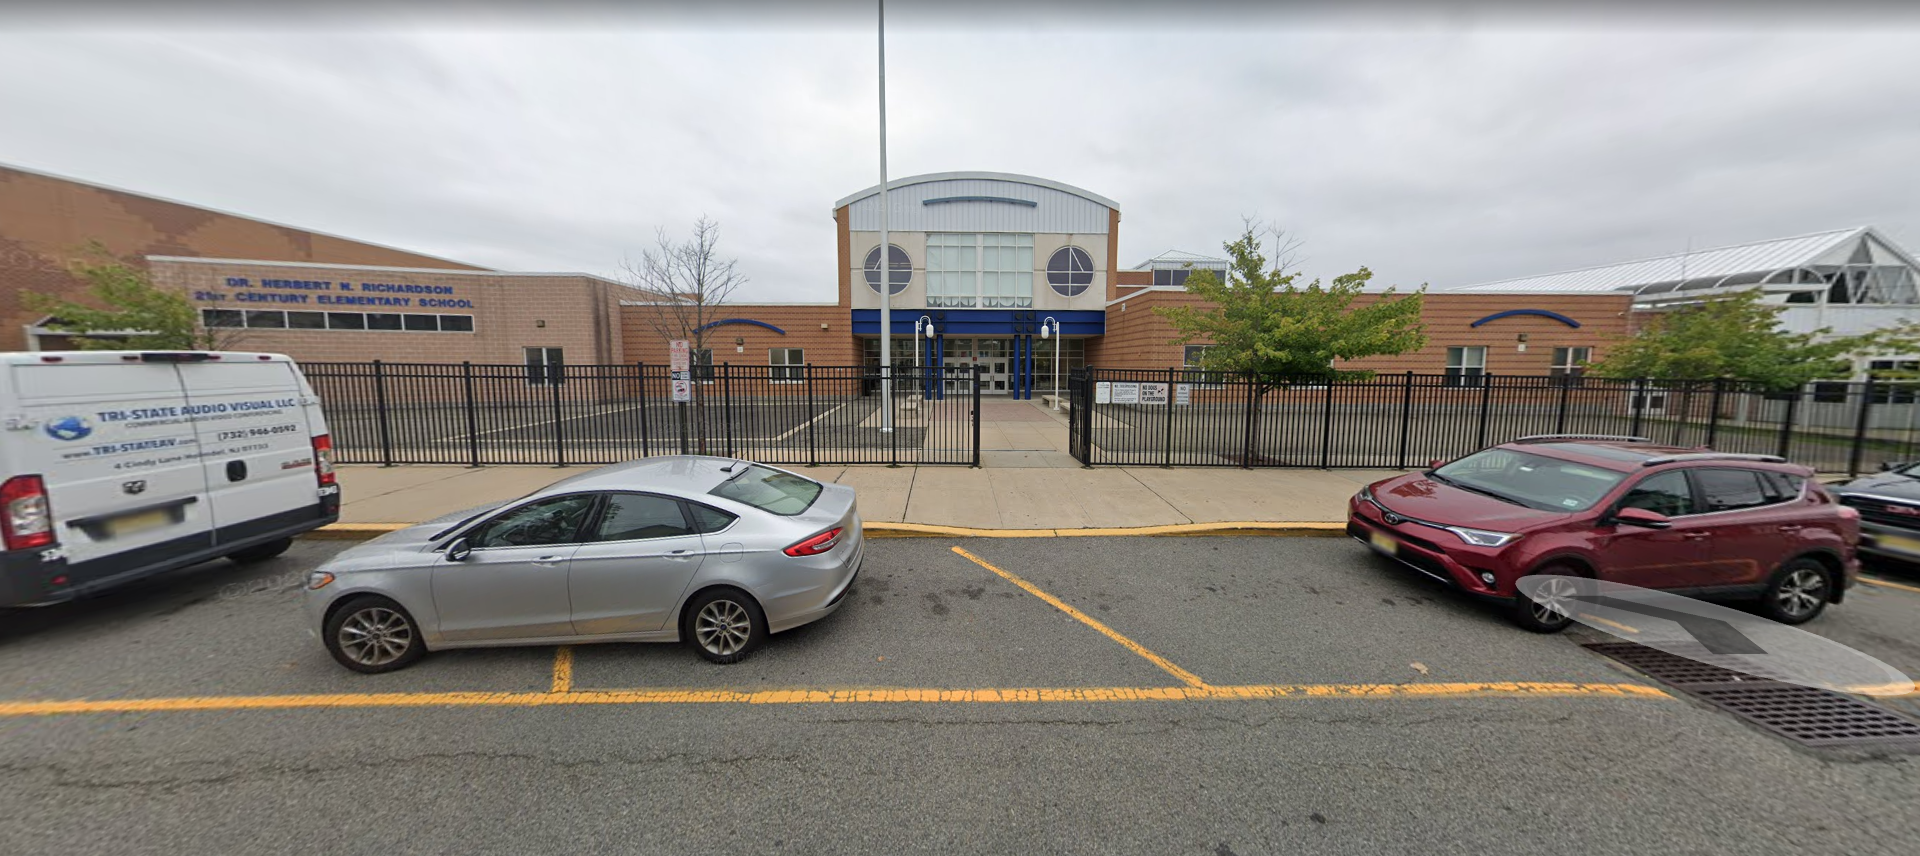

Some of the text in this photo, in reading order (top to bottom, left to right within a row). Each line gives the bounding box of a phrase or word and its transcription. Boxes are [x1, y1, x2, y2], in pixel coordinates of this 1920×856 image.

[225, 277, 253, 288] DR.
[261, 279, 332, 291] HERBERT
[361, 282, 454, 295] RICHARDSON
[235, 291, 309, 304] CENTURY
[317, 294, 412, 307] ELEMENTARY
[419, 297, 474, 309] SCHOOL
[96, 398, 296, 422] TRI-STATE AUDIO VISUAL LLC
